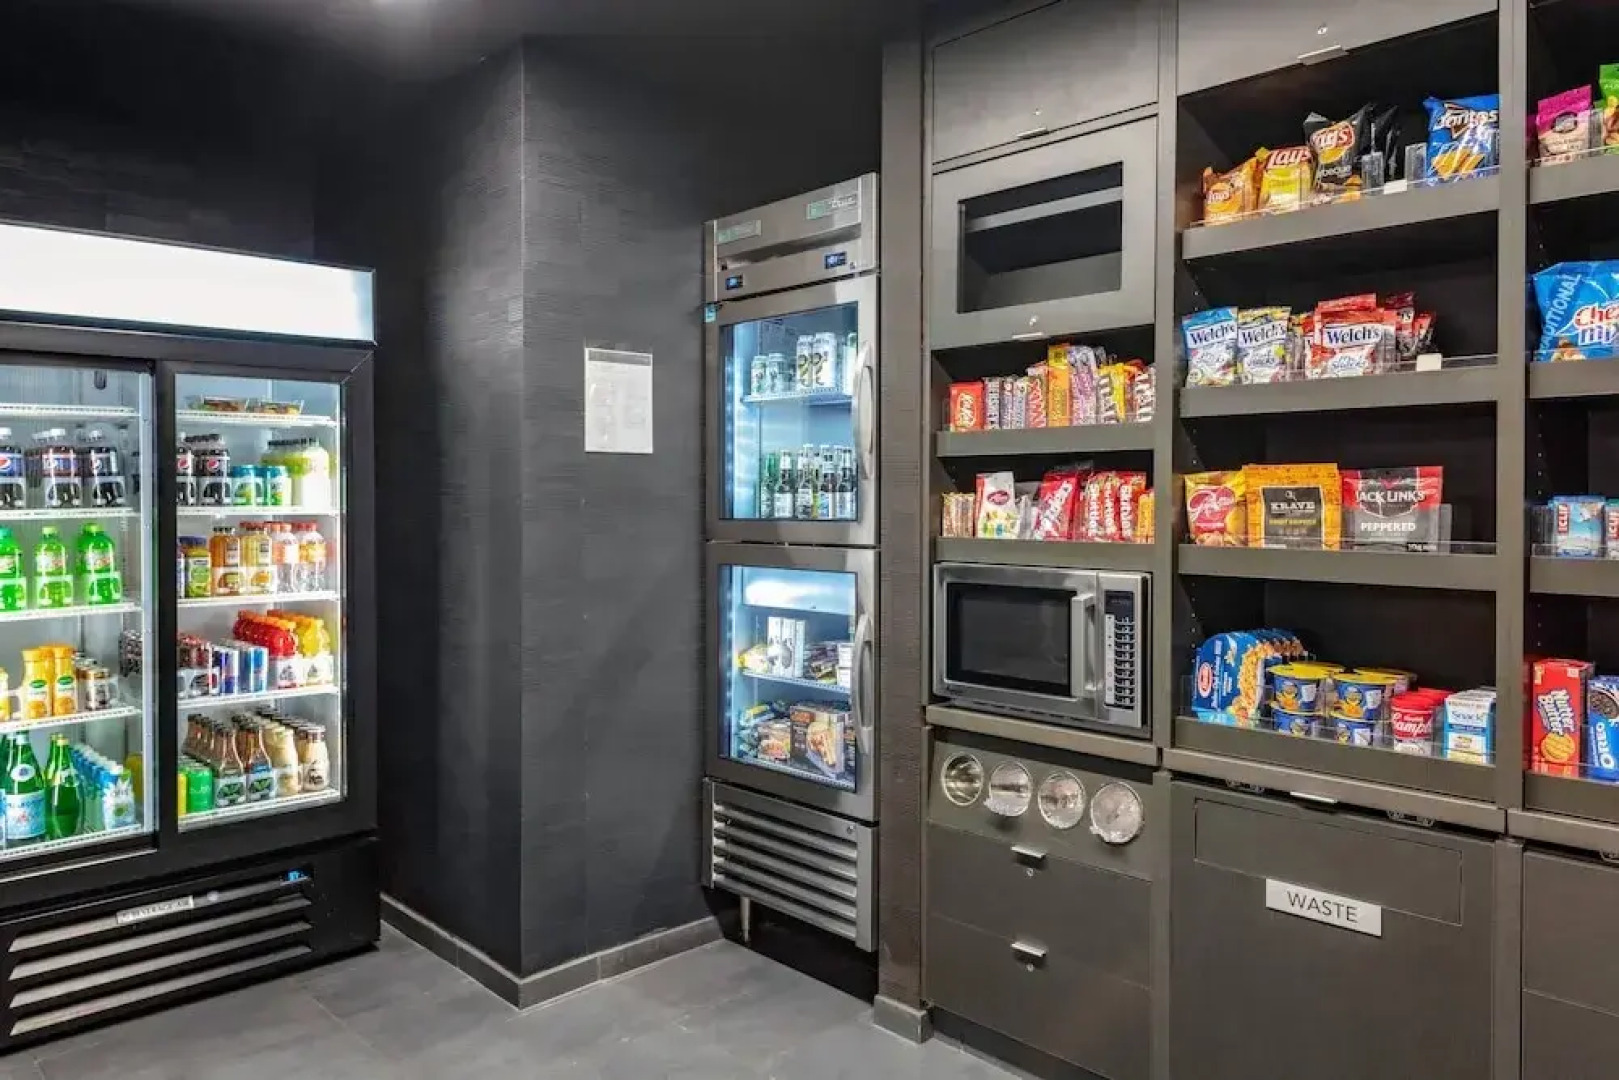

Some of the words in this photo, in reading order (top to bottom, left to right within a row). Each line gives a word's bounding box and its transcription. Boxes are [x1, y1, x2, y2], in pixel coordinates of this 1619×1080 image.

[1190, 324, 1235, 345] Welch's
[1242, 323, 1286, 344] Welch's
[1327, 326, 1381, 344] Welch's
[1361, 522, 1416, 532] PEPPERED
[1537, 694, 1565, 736] Butter
[1551, 688, 1575, 733] Nutter
[1596, 721, 1616, 770] OREO
[1286, 890, 1358, 923] WASTE
